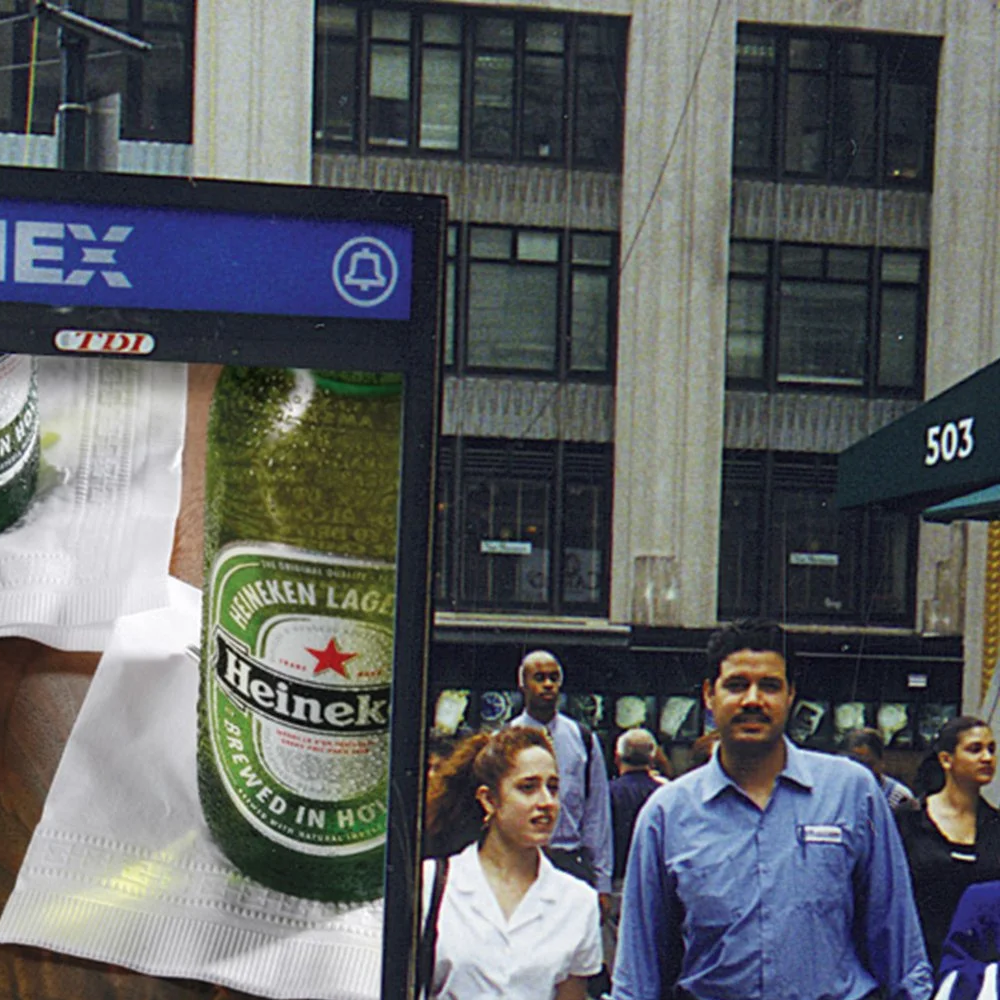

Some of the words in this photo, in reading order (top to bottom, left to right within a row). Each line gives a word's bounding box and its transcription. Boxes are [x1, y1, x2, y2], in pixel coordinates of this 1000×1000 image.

[75, 331, 146, 352] TDI
[924, 416, 975, 467] 503
[229, 578, 317, 631] HEINEKEN
[223, 645, 392, 728] Heinek
[223, 718, 288, 816] BREWED
[295, 806, 326, 829] IN
